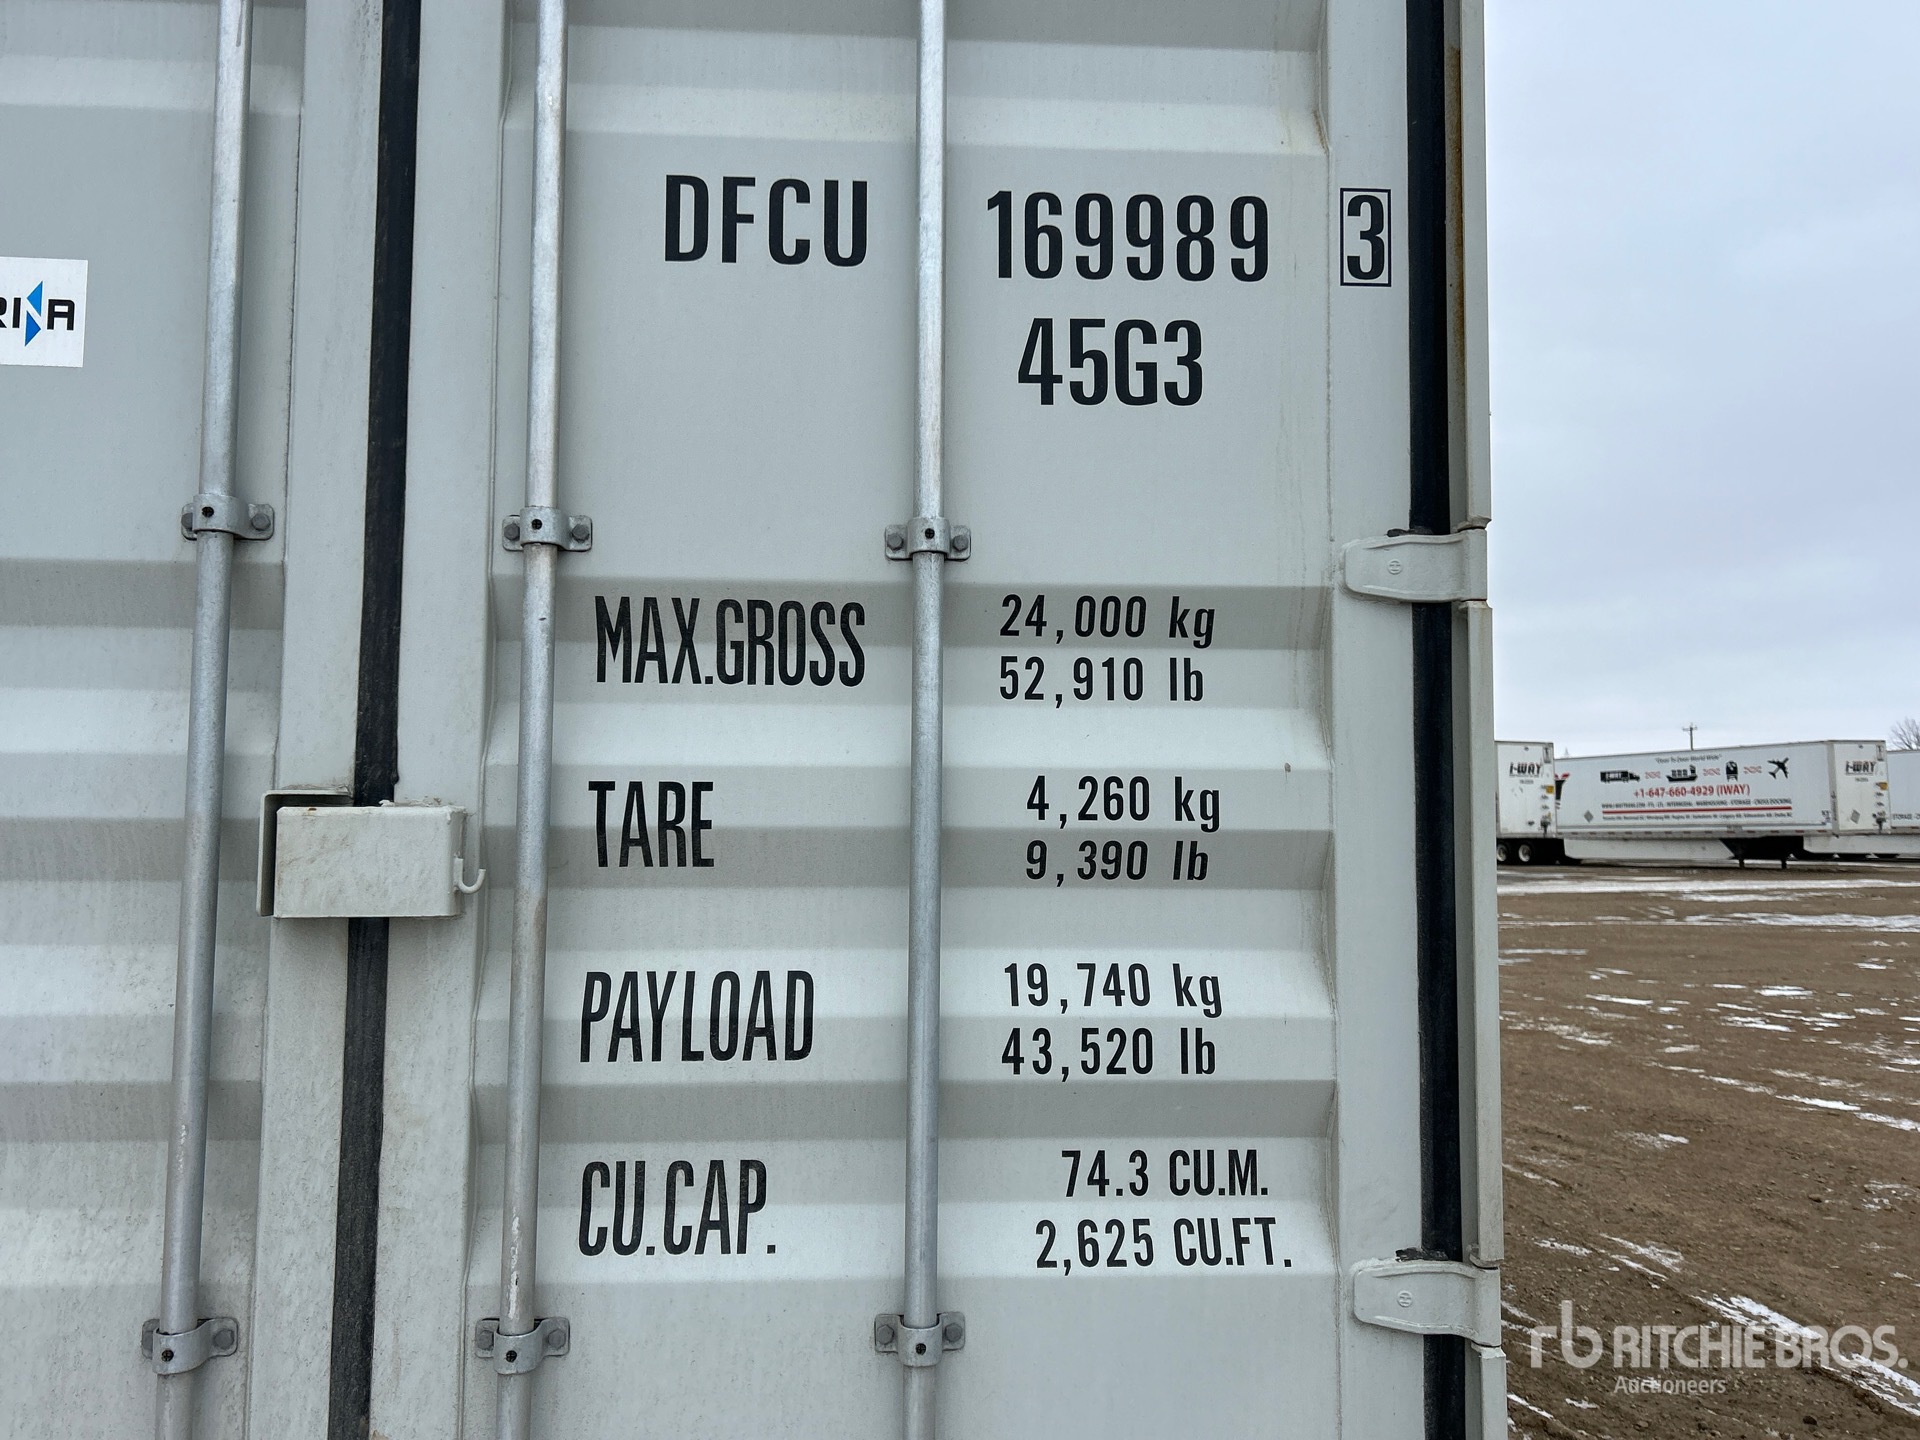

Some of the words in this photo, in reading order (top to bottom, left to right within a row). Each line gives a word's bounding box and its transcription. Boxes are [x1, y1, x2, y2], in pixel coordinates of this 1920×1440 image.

[664, 174, 868, 267] DFCU
[987, 190, 1269, 283] 169989
[1346, 194, 1386, 281] 3
[0, 281, 75, 346] INA
[1017, 317, 1203, 407] 45G3
[594, 595, 866, 688] MAX.GROSS
[999, 593, 1147, 645] 24,000
[1168, 595, 1216, 650] kg
[999, 654, 1144, 709] 52,910
[1169, 657, 1204, 702] lb
[588, 780, 715, 868] TARE
[1026, 775, 1150, 830] 4,260
[1174, 776, 1220, 834] kg
[1716, 784, 1750, 797] (IWAY)
[1025, 839, 1149, 888] 9,390
[1172, 840, 1209, 881] lb
[579, 970, 814, 1063] PAYLOAD
[1004, 962, 1151, 1015] 19,740
[1172, 963, 1222, 1019] kg
[1001, 1027, 1153, 1083] 43,520
[1180, 1027, 1216, 1075] lb
[578, 1159, 776, 1257] CU.CAP.
[1061, 1149, 1149, 1198] 74.3
[1169, 1149, 1268, 1197] CU.M.
[1035, 1218, 1154, 1276] 2,625
[1173, 1217, 1292, 1268] CU.FT.
